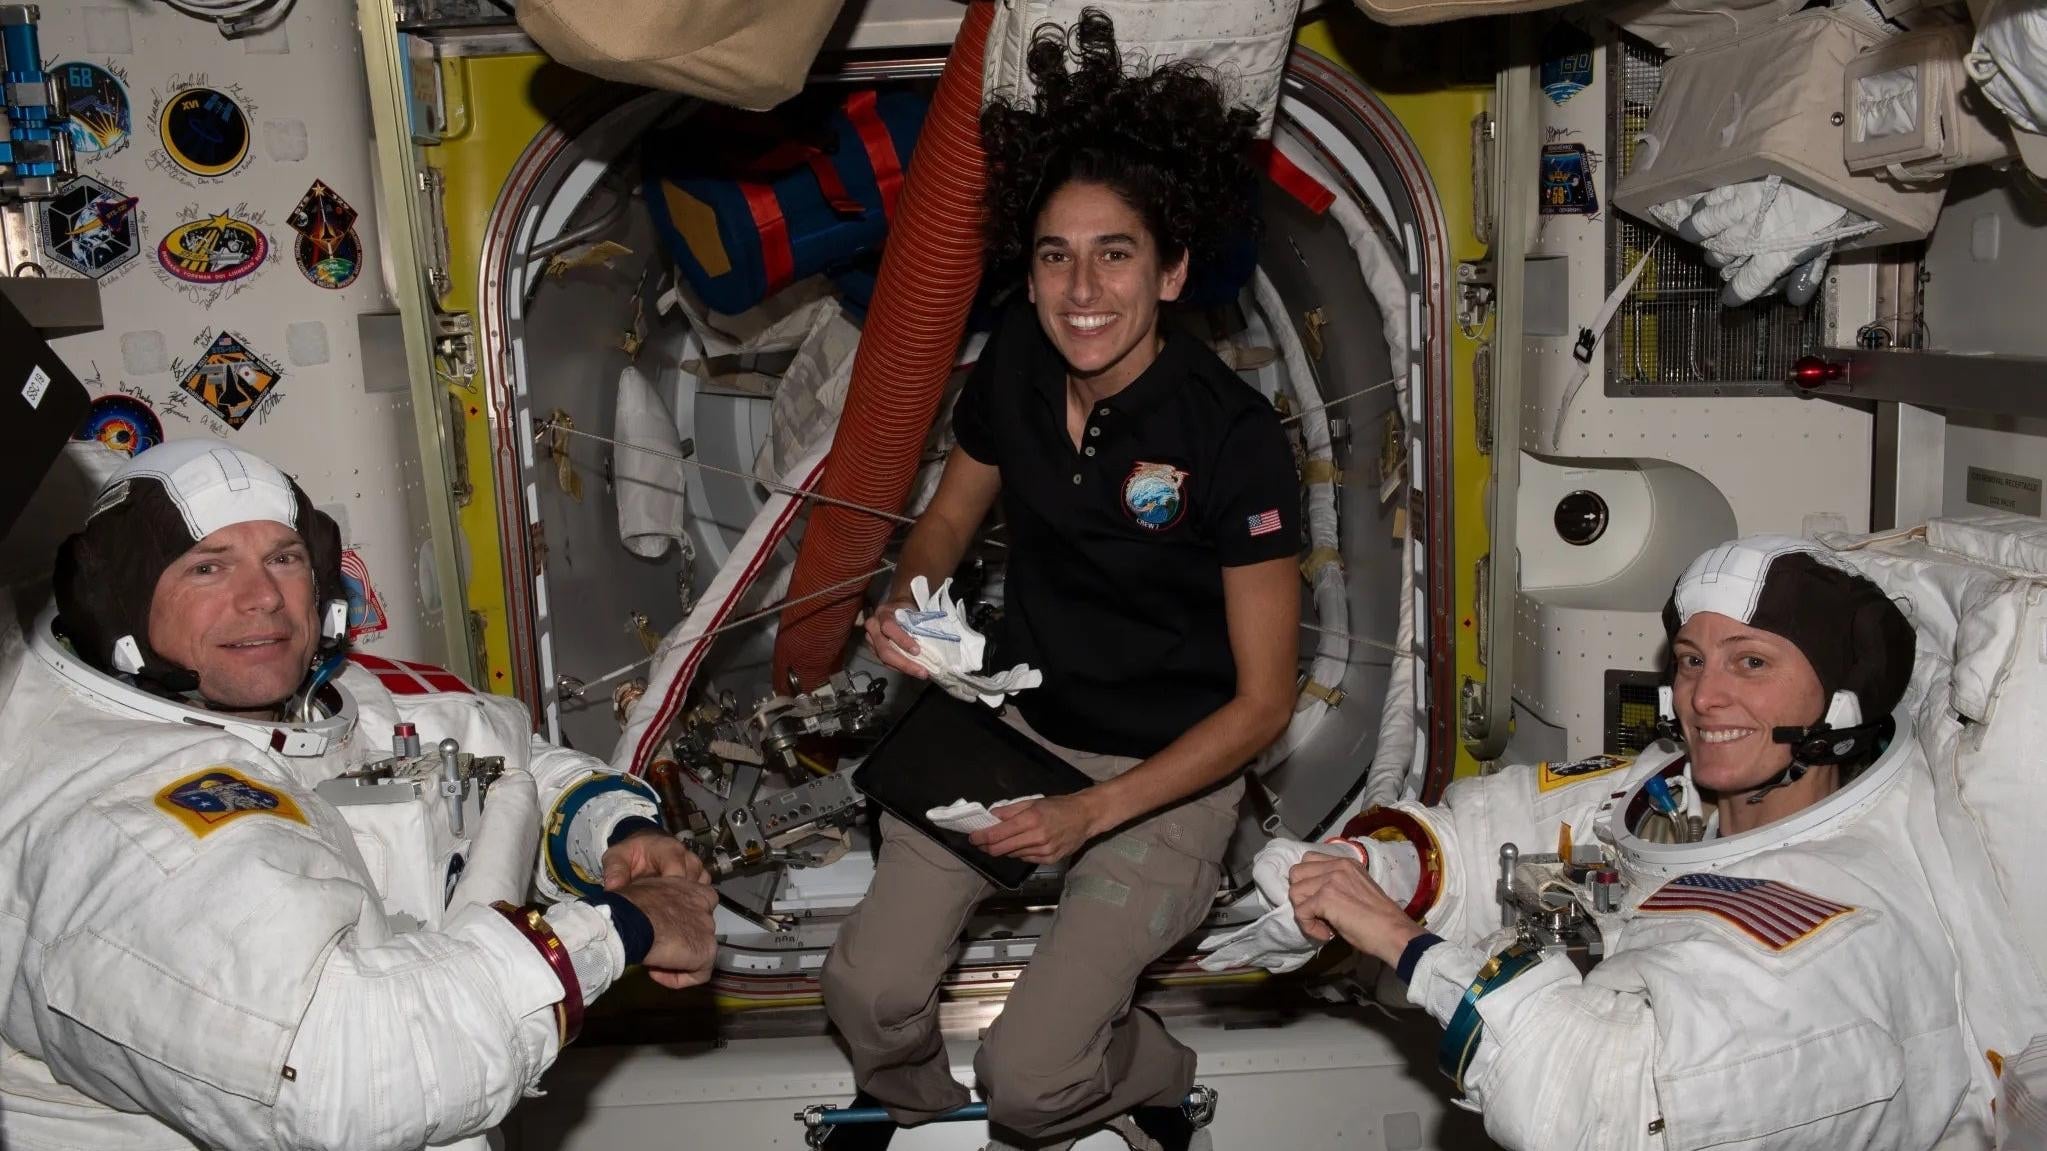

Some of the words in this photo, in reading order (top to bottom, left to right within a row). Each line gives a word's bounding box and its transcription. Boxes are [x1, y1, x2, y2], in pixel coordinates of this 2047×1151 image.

[69, 67, 92, 87] 68
[182, 100, 199, 110] XVI
[1552, 186, 1565, 205] 59
[103, 254, 128, 272] PATRICK
[27, 382, 39, 400] SSC
[1136, 518, 1154, 529] CREW
